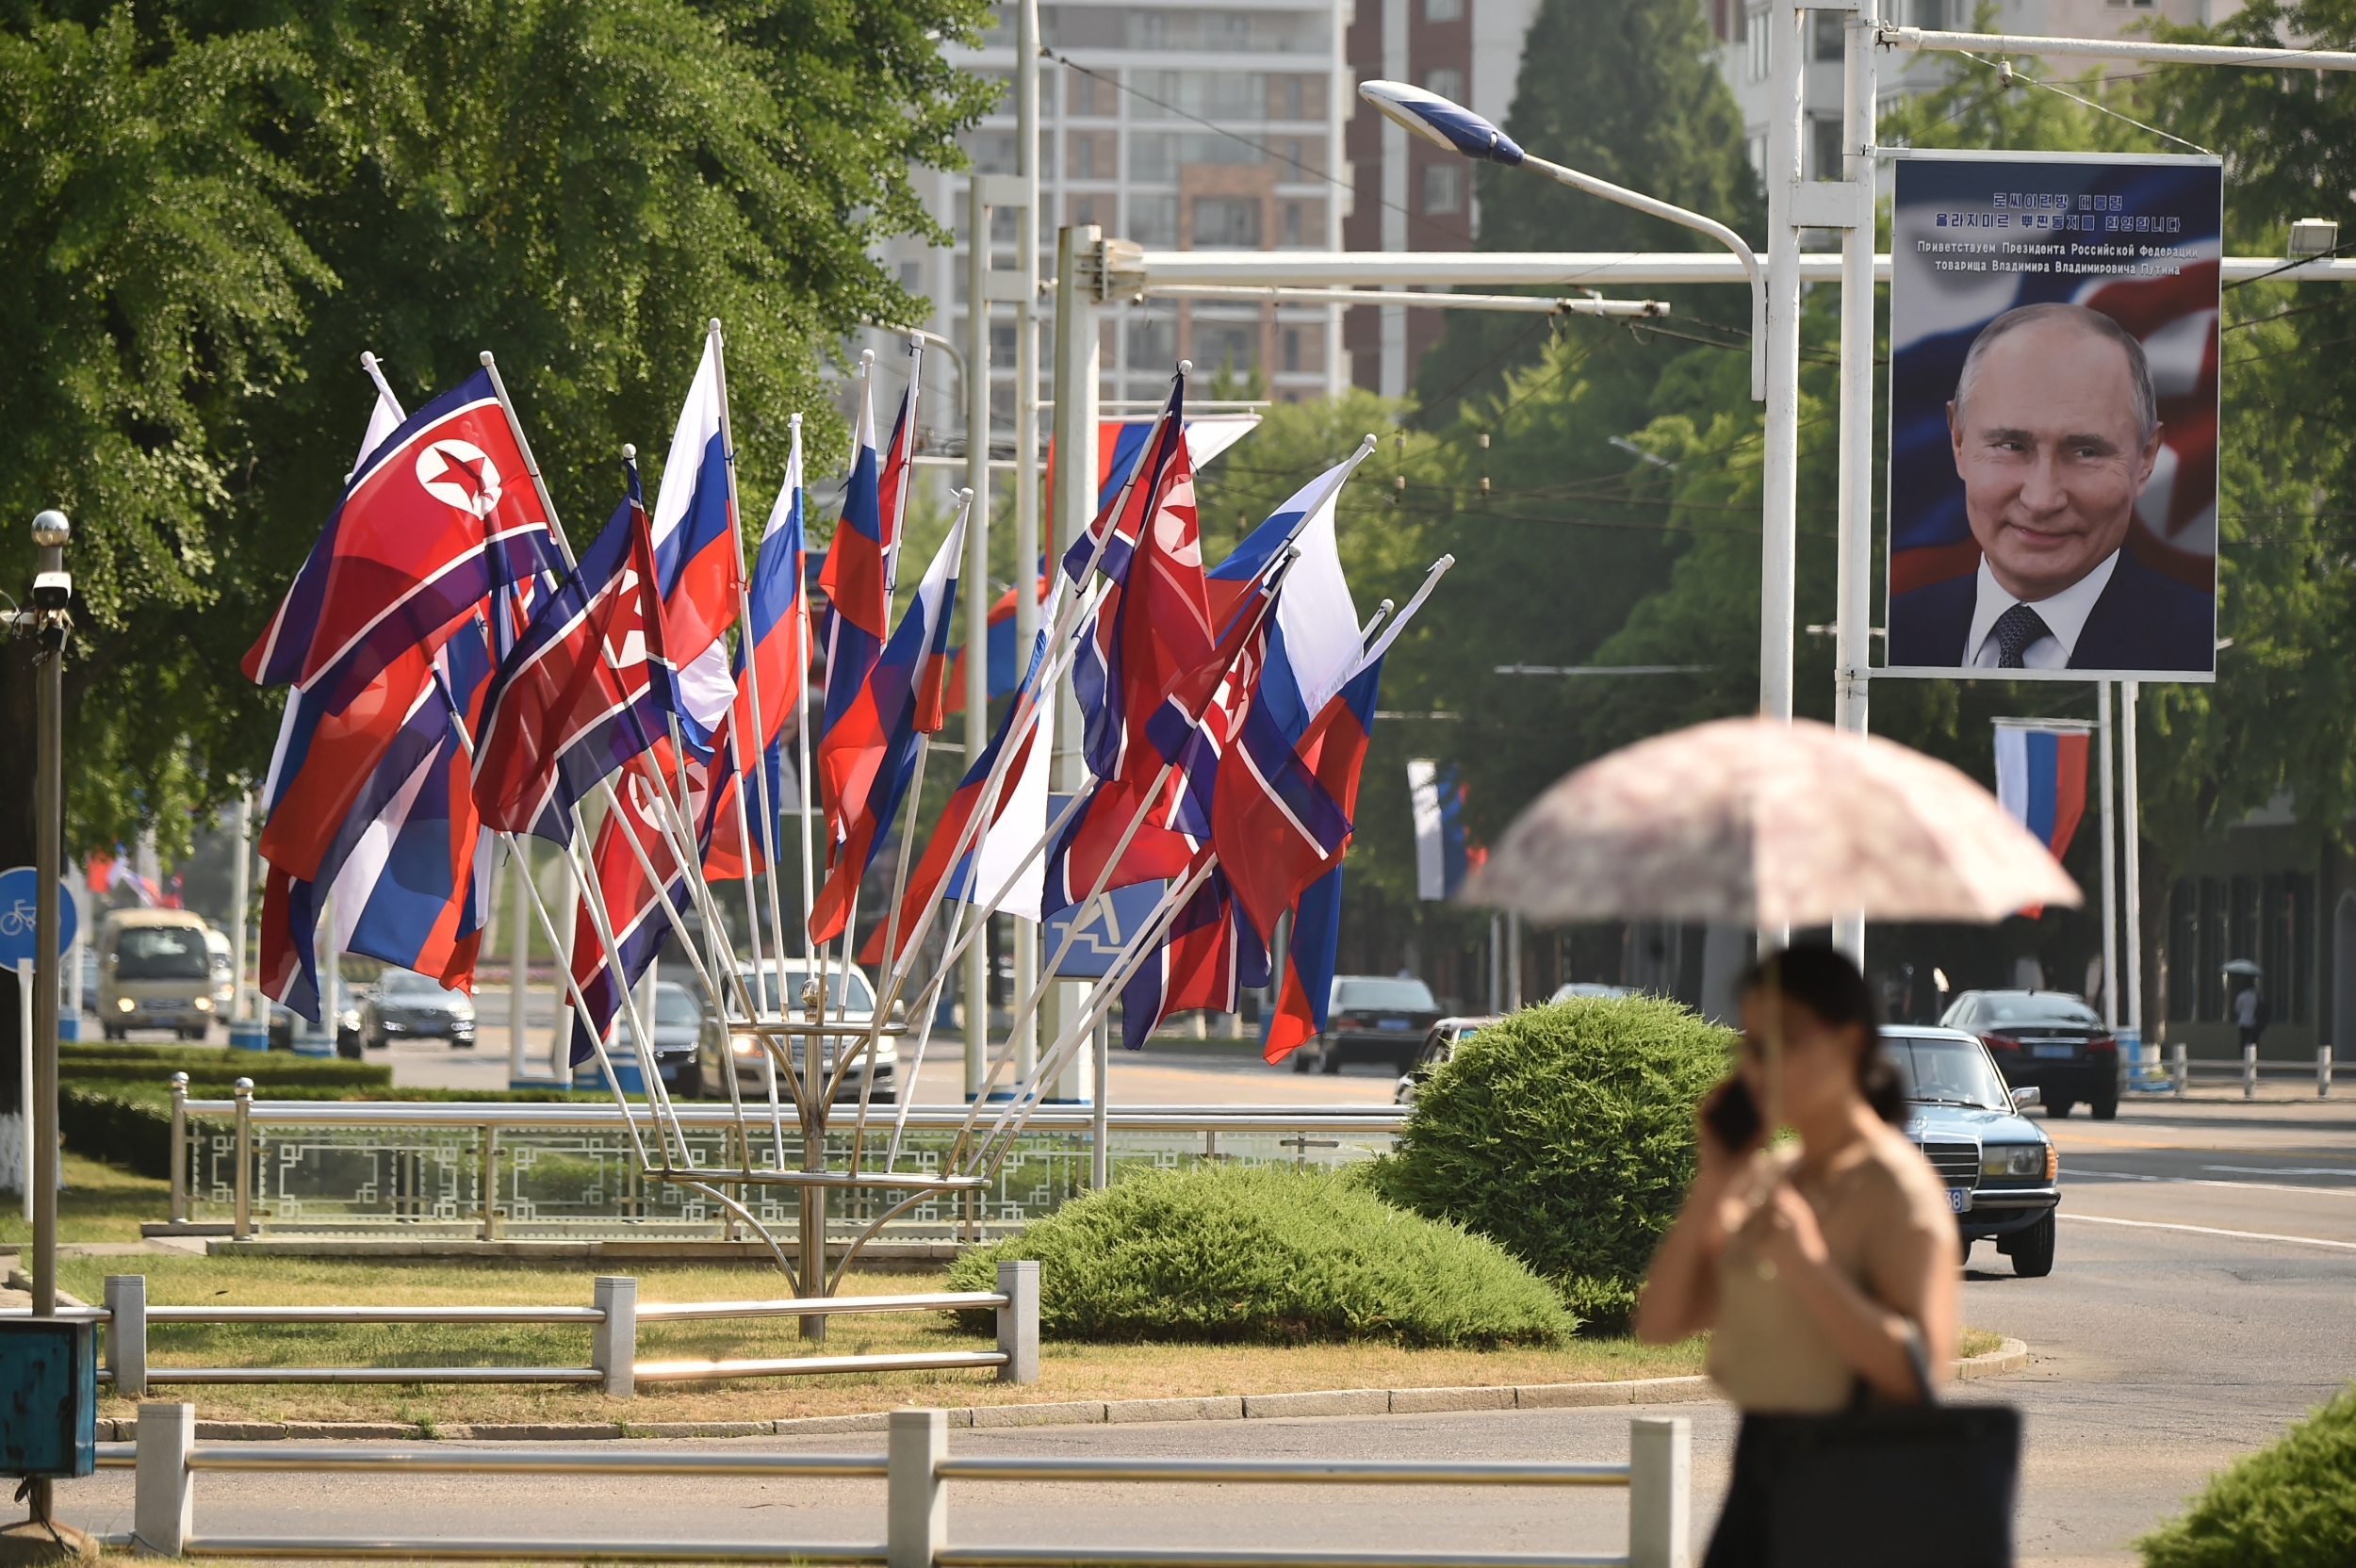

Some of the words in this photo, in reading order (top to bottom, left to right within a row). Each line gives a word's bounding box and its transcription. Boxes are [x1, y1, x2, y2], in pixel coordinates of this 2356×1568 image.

[1993, 192, 2069, 210] 로씨야련방
[2079, 194, 2122, 211] 대통령
[2105, 215, 2182, 233] 환영합니다
[1917, 240, 1996, 254] Приветствуем
[2002, 241, 2066, 256] Президента
[2070, 243, 2135, 257] Российской
[2139, 245, 2199, 259] Федерации
[1935, 260, 1987, 272] товарища
[1992, 260, 2050, 274] Владимира
[2055, 261, 2135, 275] Владимировича
[2140, 263, 2181, 276] Путина
